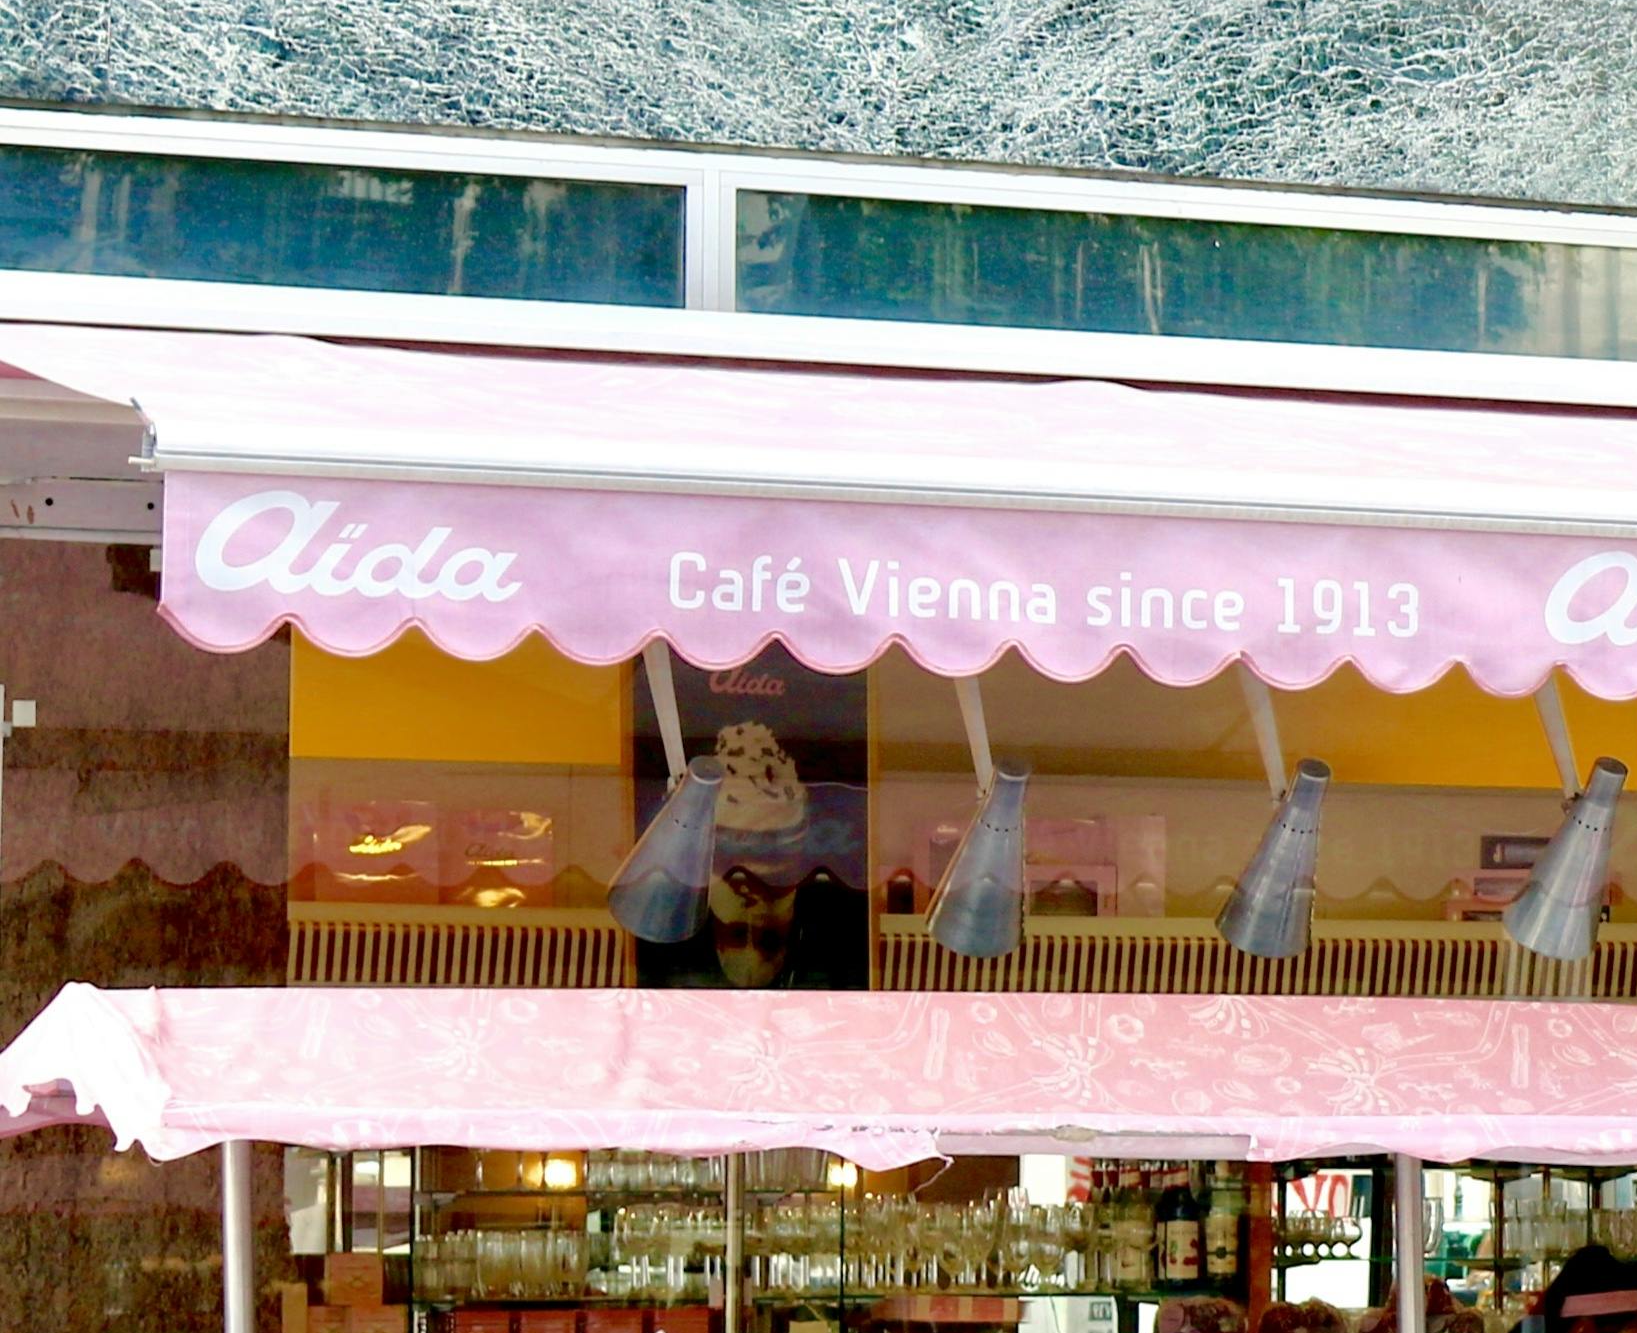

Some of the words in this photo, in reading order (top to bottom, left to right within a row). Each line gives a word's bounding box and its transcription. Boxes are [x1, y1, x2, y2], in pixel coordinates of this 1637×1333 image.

[669, 551, 811, 614] Café
[837, 557, 1057, 625] Vienna
[1086, 571, 1245, 632] since
[1277, 577, 1419, 638] 1913
